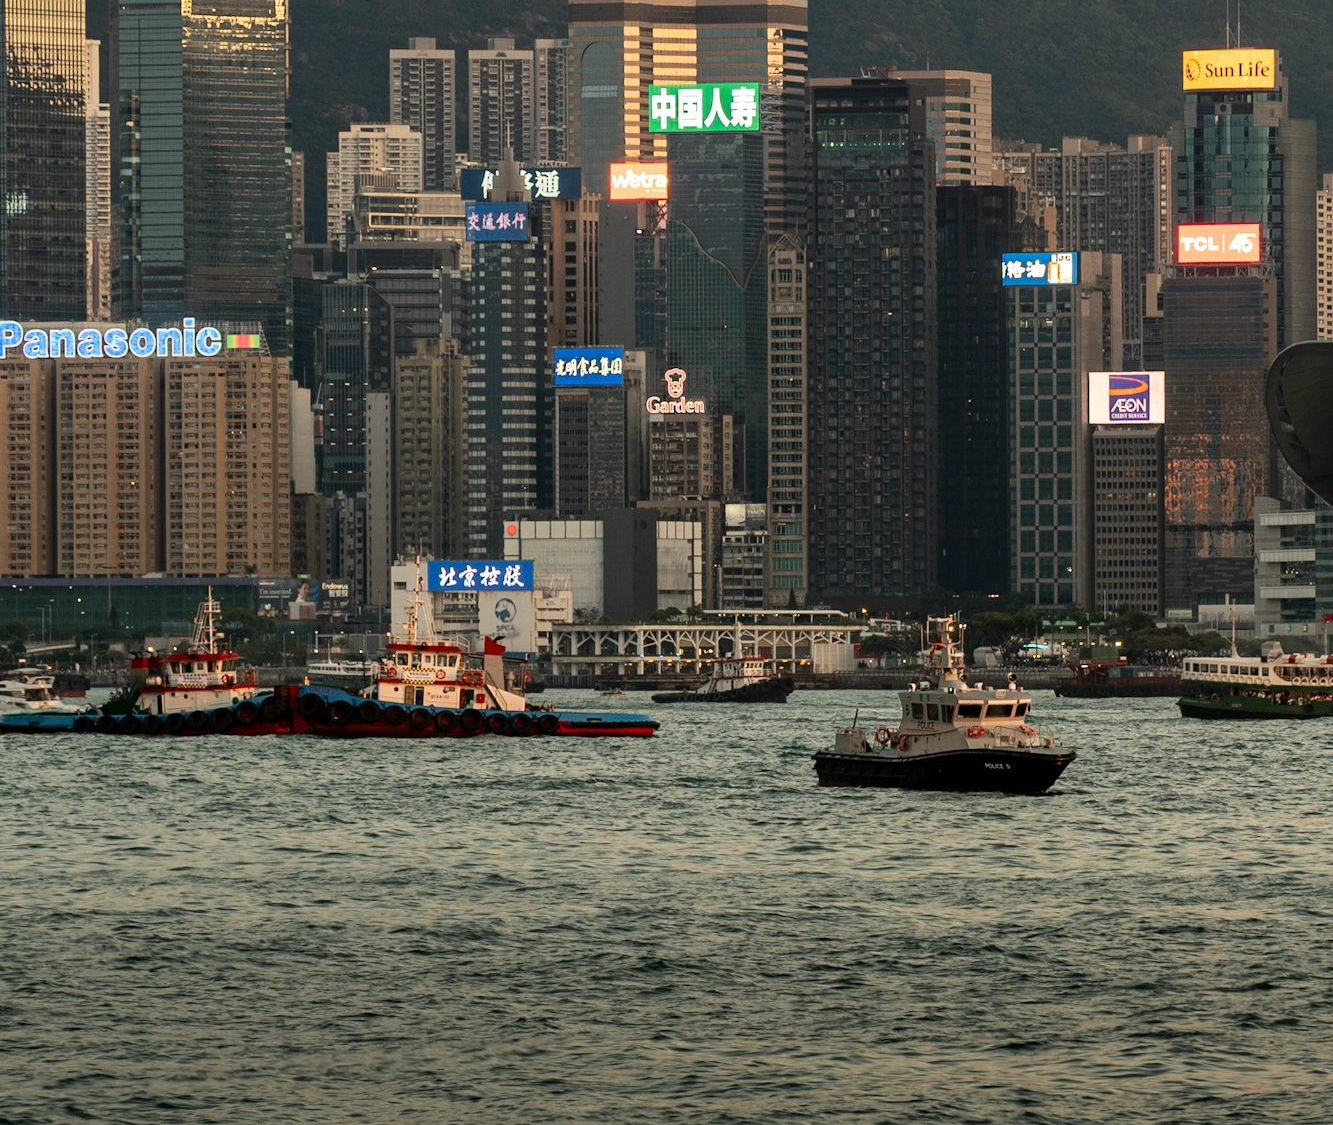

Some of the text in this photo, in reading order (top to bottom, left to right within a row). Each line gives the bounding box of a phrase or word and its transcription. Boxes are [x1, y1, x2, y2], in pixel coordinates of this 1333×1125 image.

[1205, 60, 1270, 77] Sun Life
[651, 86, 757, 130] 中国人寿
[467, 211, 527, 232] 交通銀行
[1180, 236, 1219, 252] TCL
[0, 317, 222, 359] Panasonic
[646, 396, 705, 414] Garden
[438, 564, 525, 587] 北京控股
[495, 624, 516, 632] SPCA
[905, 705, 910, 716] 5
[917, 721, 935, 730] POLICE
[984, 762, 1004, 770] POLICE
